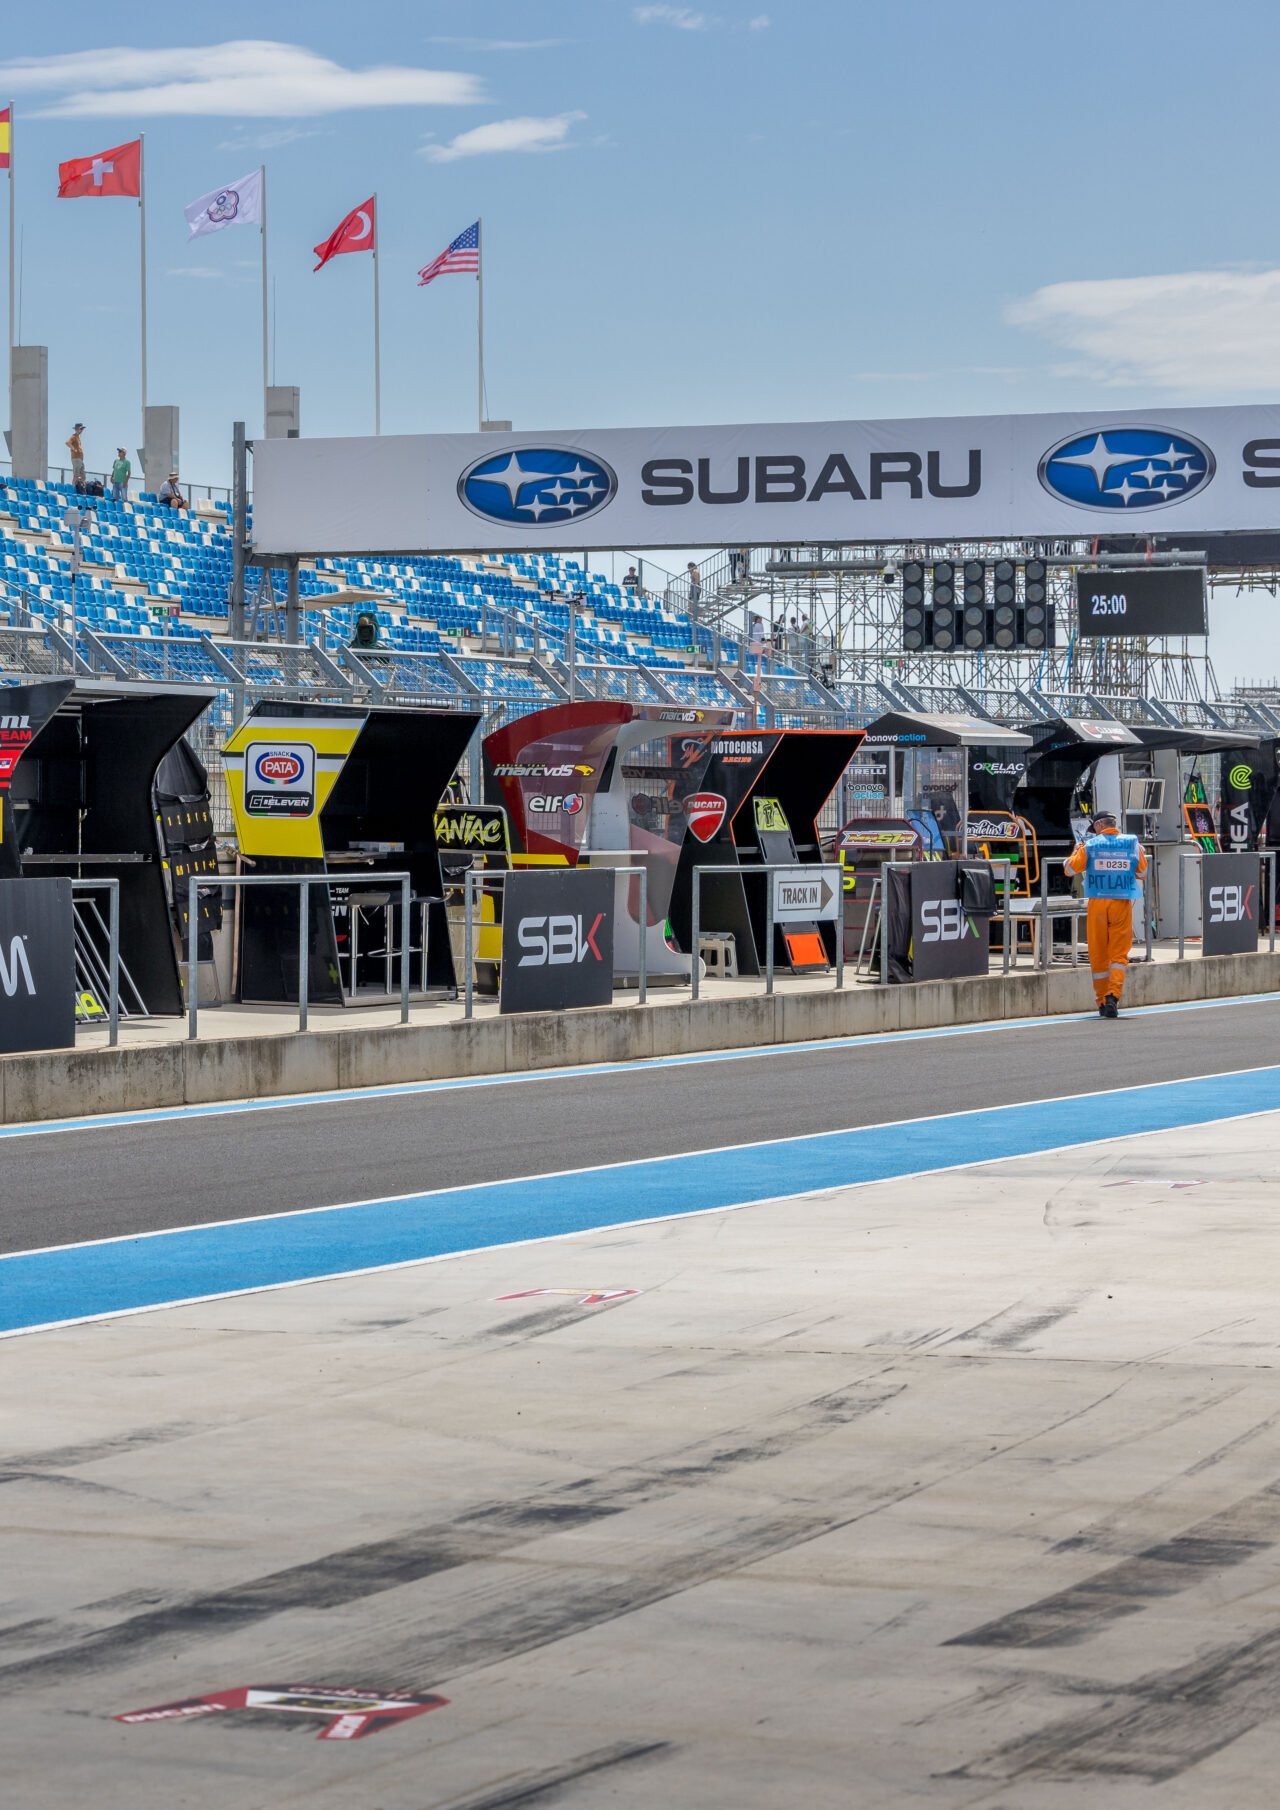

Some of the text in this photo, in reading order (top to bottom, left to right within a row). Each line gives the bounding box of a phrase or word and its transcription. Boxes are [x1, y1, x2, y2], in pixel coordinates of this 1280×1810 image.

[641, 449, 981, 505] SUBARU
[1091, 595, 1127, 614] 25:00
[711, 741, 763, 754] MOTOCORSA
[265, 762, 294, 773] PATA
[974, 763, 1024, 775] ORELAC
[848, 783, 883, 791] bonovo
[530, 796, 562, 812] elf
[434, 813, 501, 845] ANIAC
[1106, 861, 1127, 869] 0235
[1088, 874, 1136, 891] PIT LANE
[783, 887, 818, 904] TRACK IN
[1210, 885, 1252, 922] SBK
[518, 913, 603, 966] SBK
[122, 1704, 227, 1723] DUCATI
